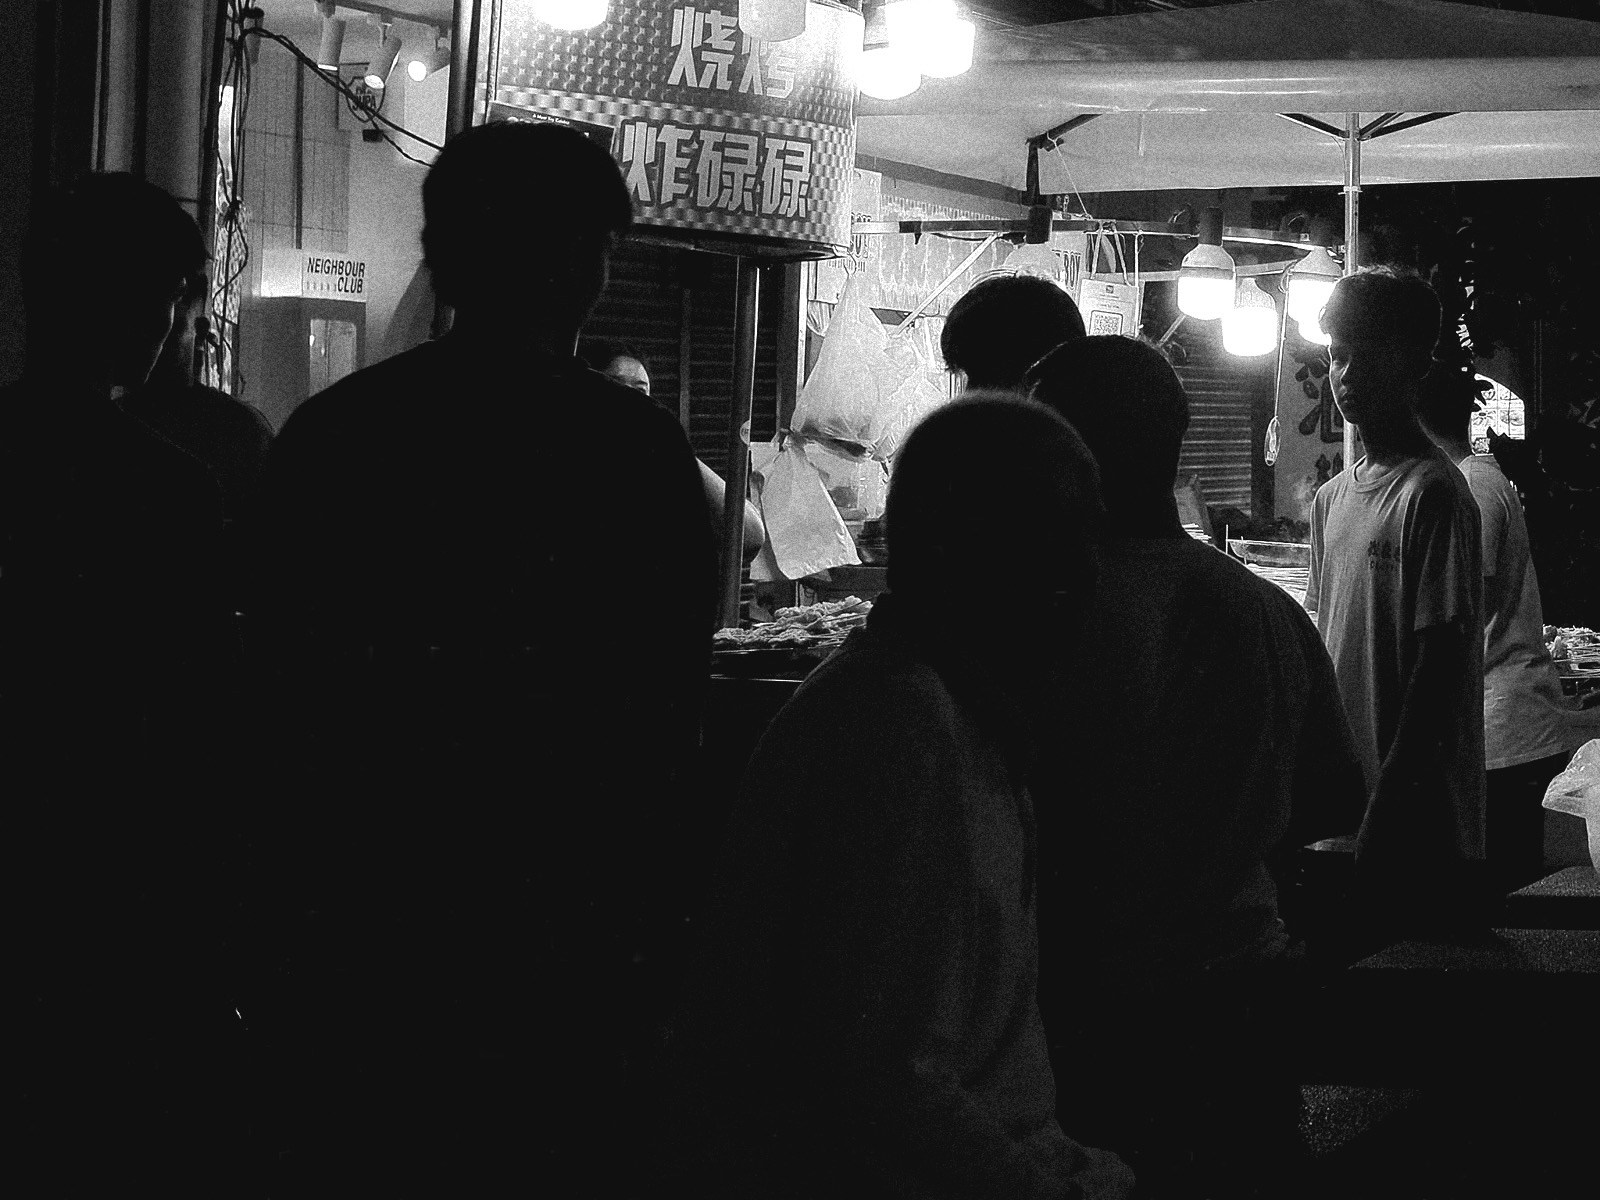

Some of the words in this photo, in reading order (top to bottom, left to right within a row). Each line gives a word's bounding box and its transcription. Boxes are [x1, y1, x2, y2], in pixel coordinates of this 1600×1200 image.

[619, 120, 813, 219] 炸碌碌
[307, 257, 366, 278] NEIGHBOUR
[337, 276, 364, 293] CLUB
